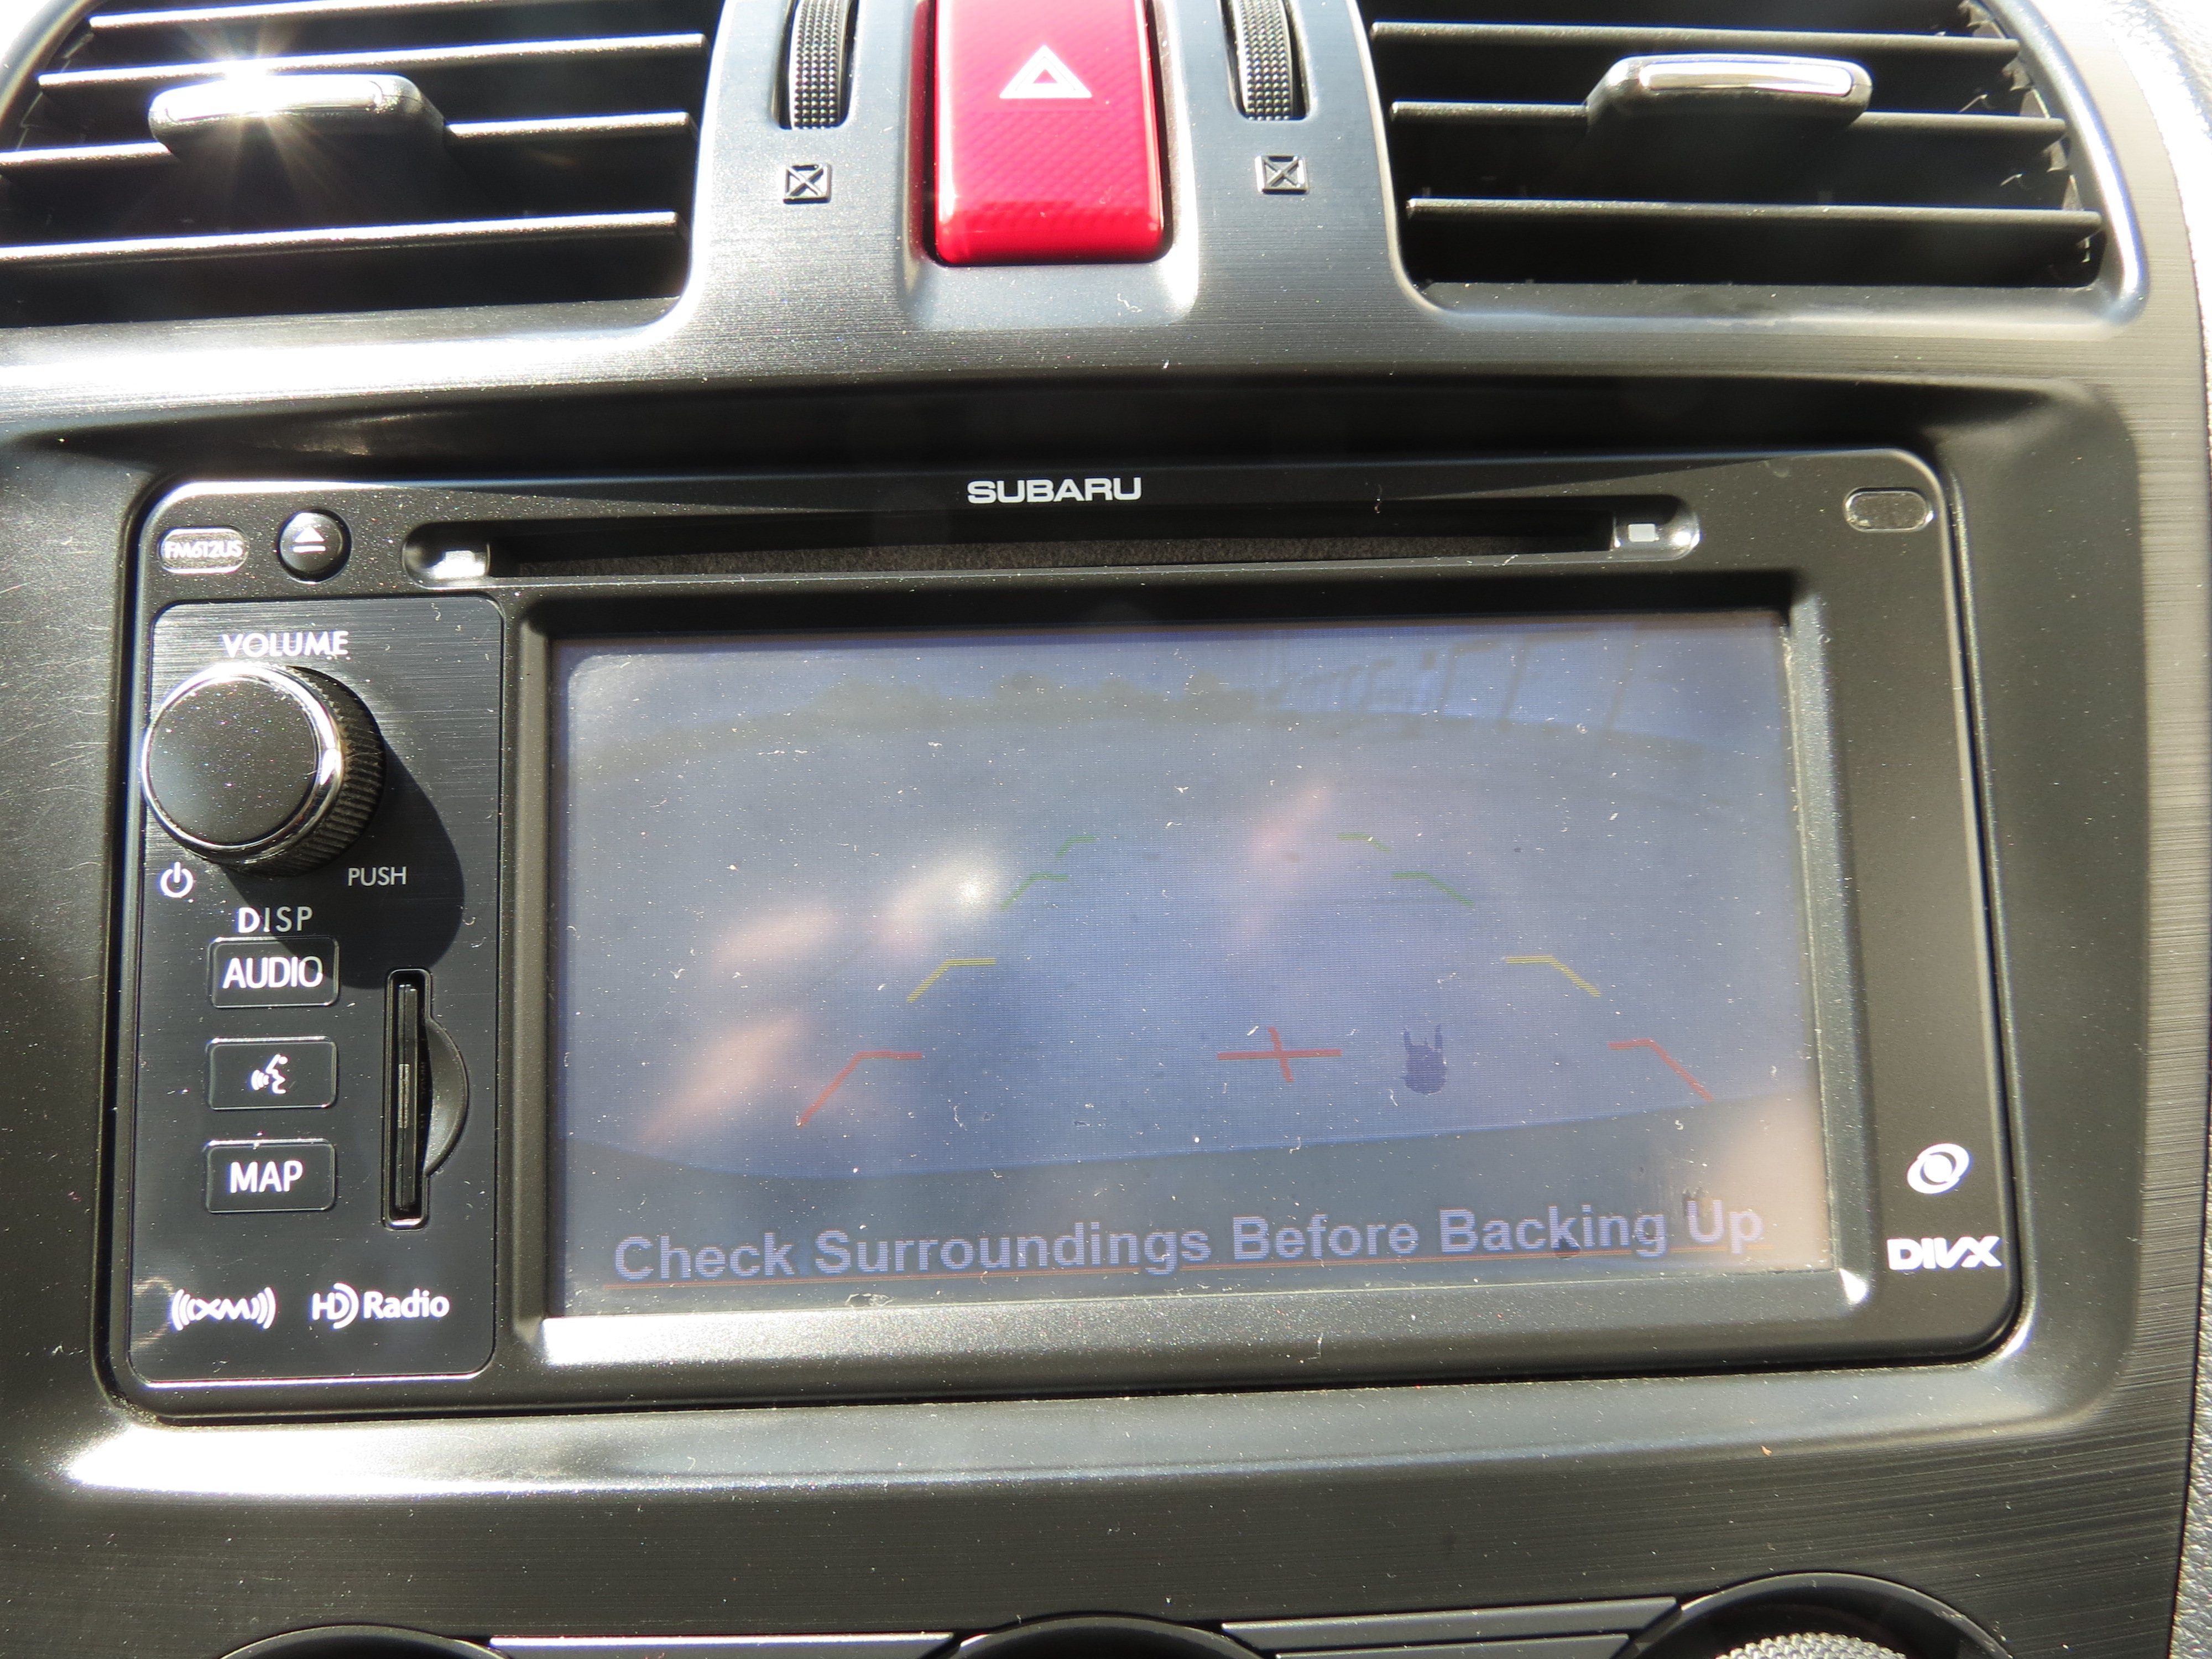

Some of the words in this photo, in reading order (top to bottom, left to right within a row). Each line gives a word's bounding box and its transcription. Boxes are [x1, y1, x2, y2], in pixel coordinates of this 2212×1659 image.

[967, 477, 1142, 504] SUBARU
[164, 540, 243, 559] FM612US
[222, 630, 349, 657] VOLUME
[348, 866, 407, 887] PUSH
[237, 905, 314, 933] DISP
[222, 956, 324, 990] AUDIO
[229, 1160, 304, 1194] MAP
[615, 1232, 796, 1281] Check
[814, 1222, 1212, 1276] Surroundings
[1232, 1214, 1419, 1261] Before
[1439, 1204, 1666, 1257] Backing
[1687, 1199, 1764, 1254] Up
[1886, 1235, 2004, 1270] DIVX
[312, 1282, 359, 1329] HD
[363, 1288, 450, 1319] Radio
